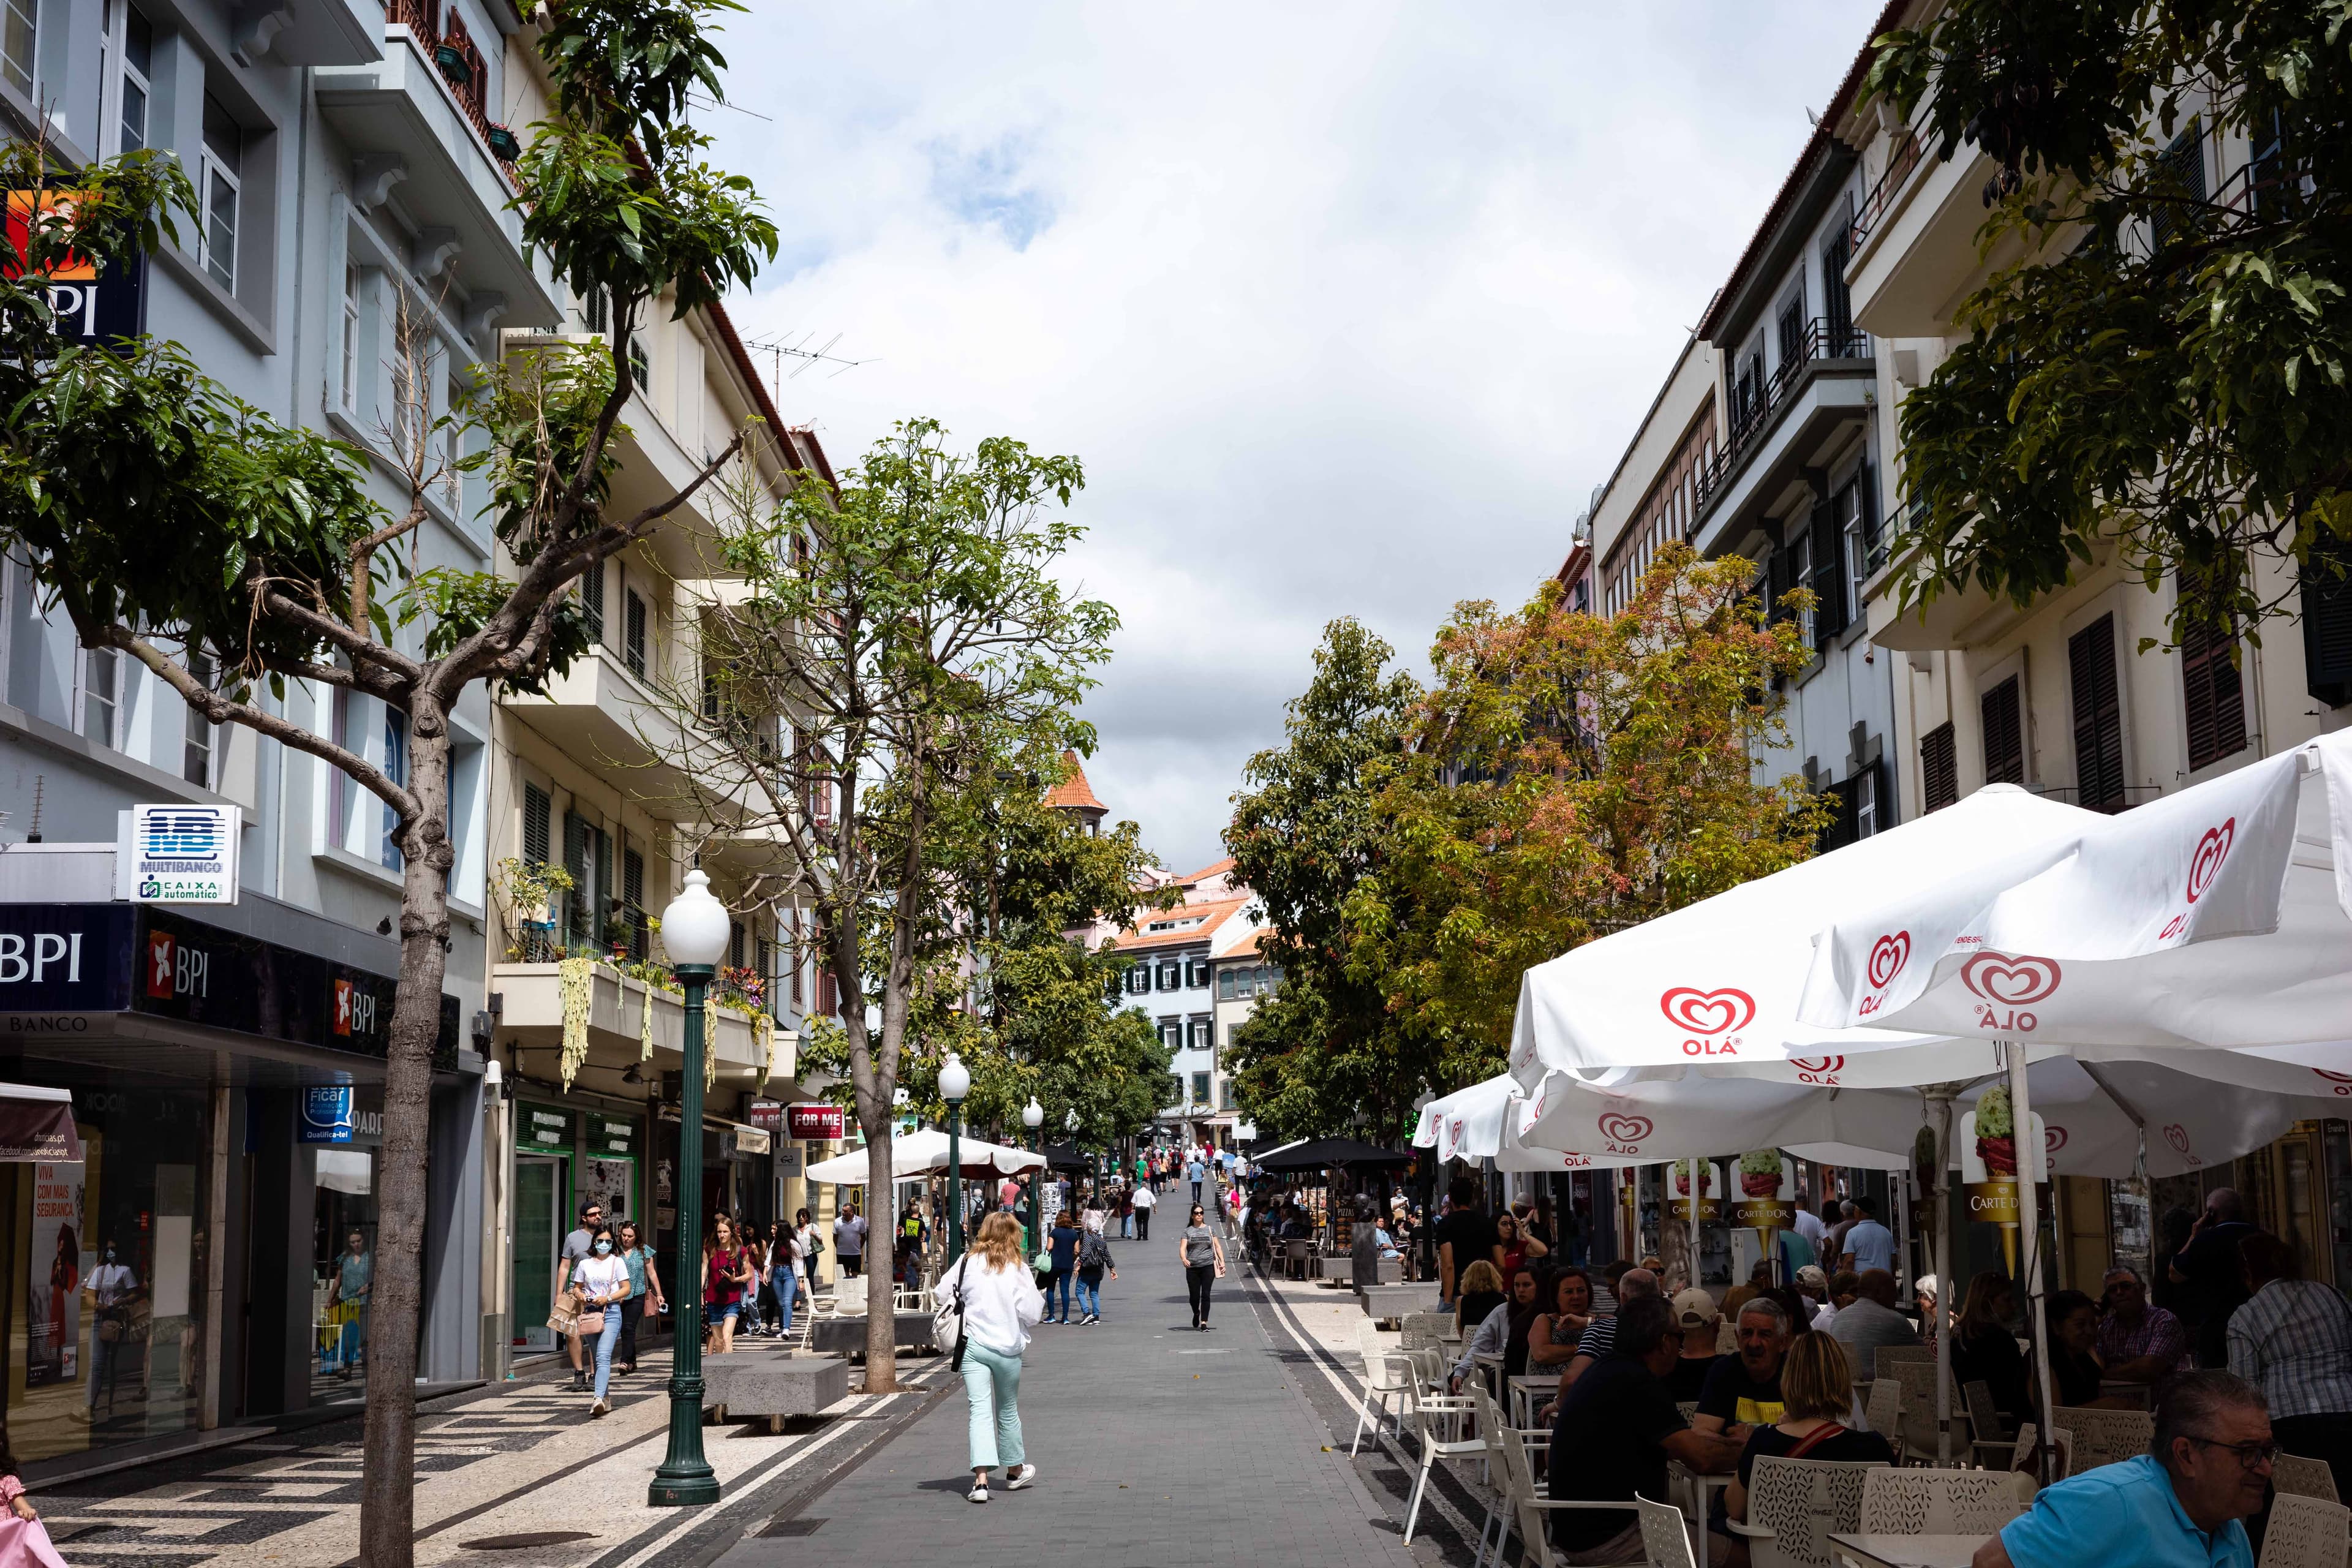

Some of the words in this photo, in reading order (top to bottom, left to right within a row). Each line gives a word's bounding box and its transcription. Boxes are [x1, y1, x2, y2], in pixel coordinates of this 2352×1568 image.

[1, 285, 98, 336] PI
[140, 861, 223, 873] MULTIBANCO
[164, 889, 217, 899] automático
[0, 933, 83, 982] BPI
[175, 946, 209, 998] BPI
[352, 991, 375, 1035] BPI
[10, 1017, 88, 1031] BANCO
[794, 1114, 818, 1126] FOR
[821, 1114, 840, 1126] ME
[38, 1166, 53, 1180] VIVA
[37, 1185, 52, 1199] COM
[53, 1185, 69, 1199] MAIS
[1672, 1205, 1691, 1214] CART
[1970, 1196, 2007, 1211] CARTE
[1737, 1209, 1764, 1219] CARTE
[1766, 1208, 1791, 1218] D'OR
